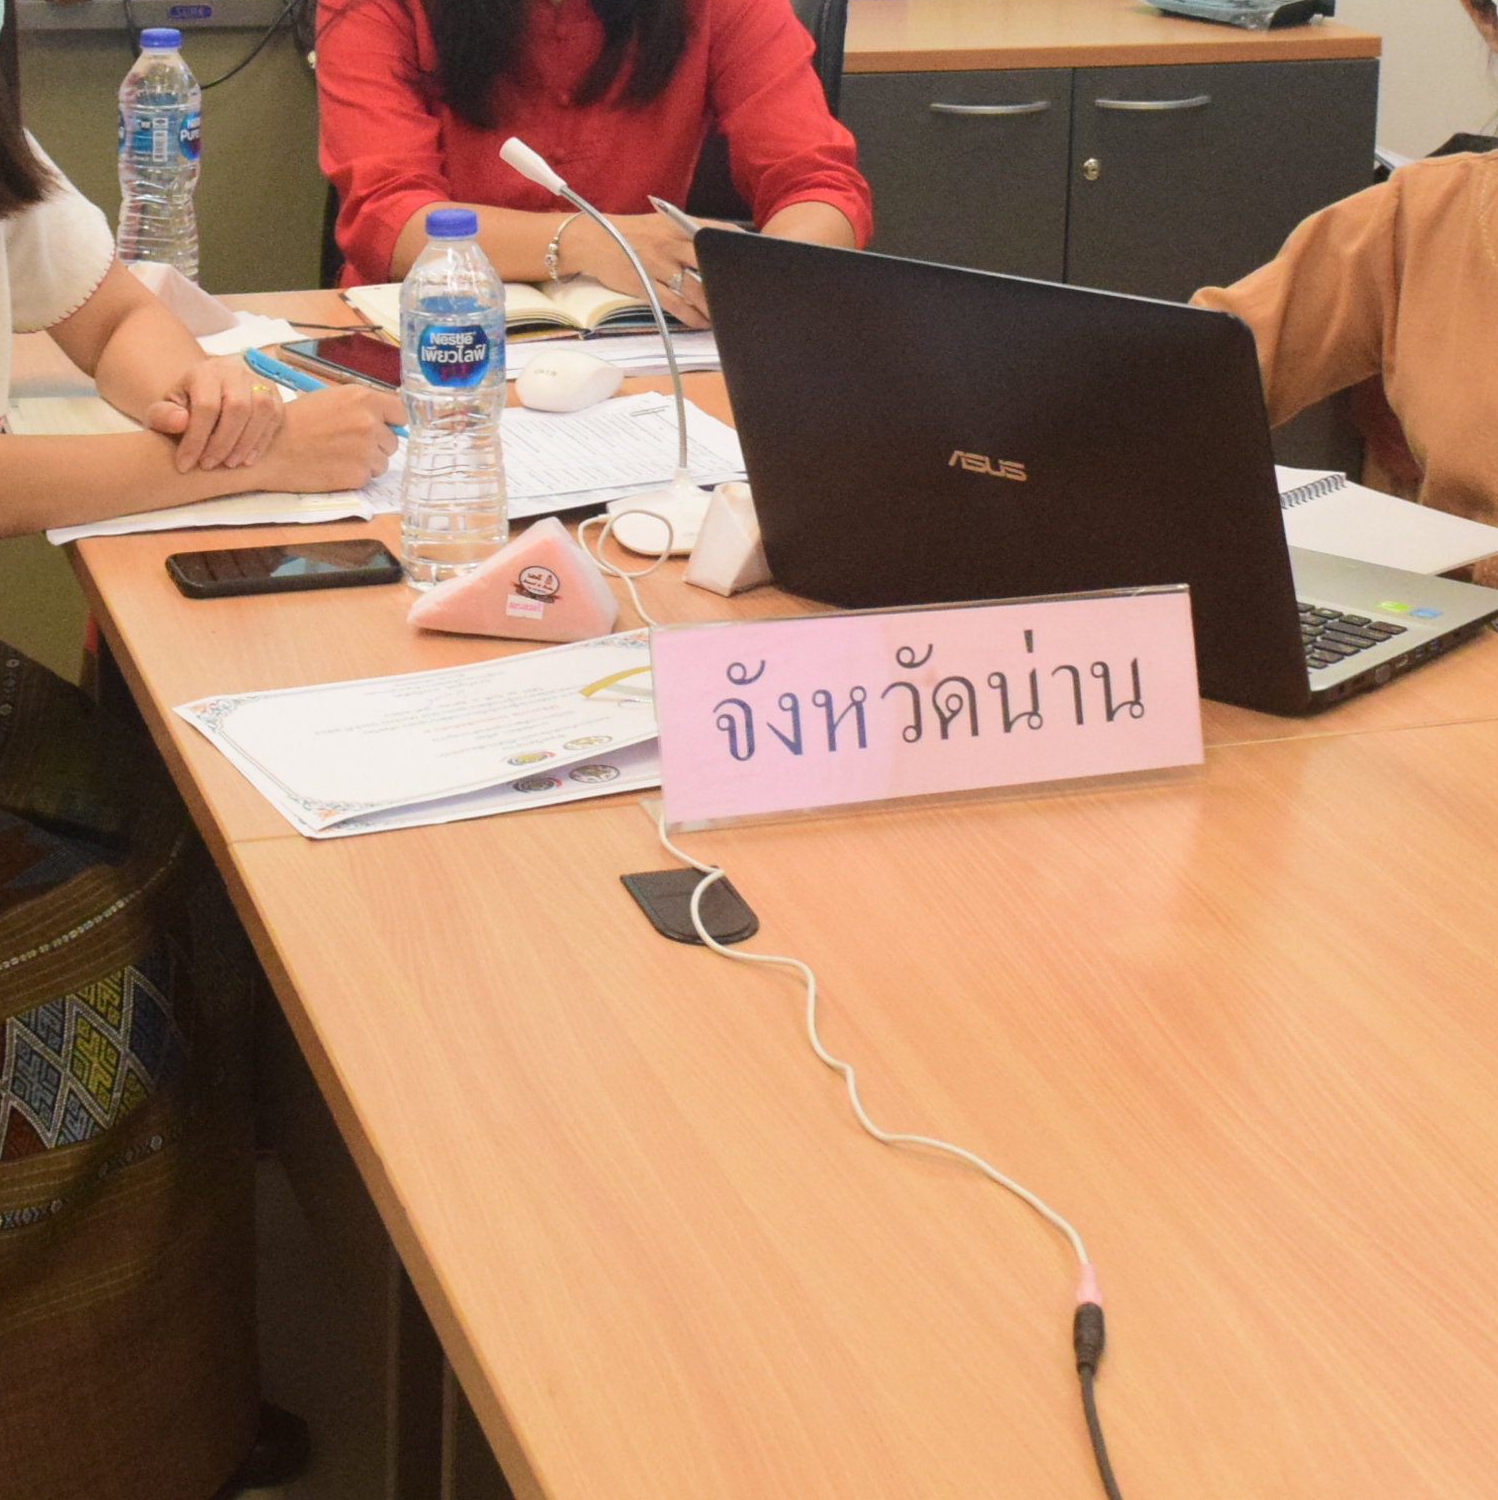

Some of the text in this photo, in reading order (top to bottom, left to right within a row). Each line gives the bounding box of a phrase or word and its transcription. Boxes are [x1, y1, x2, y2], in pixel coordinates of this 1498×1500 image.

[947, 450, 1028, 482] ASUS
[712, 628, 1146, 763] จังหวัดน่าน
